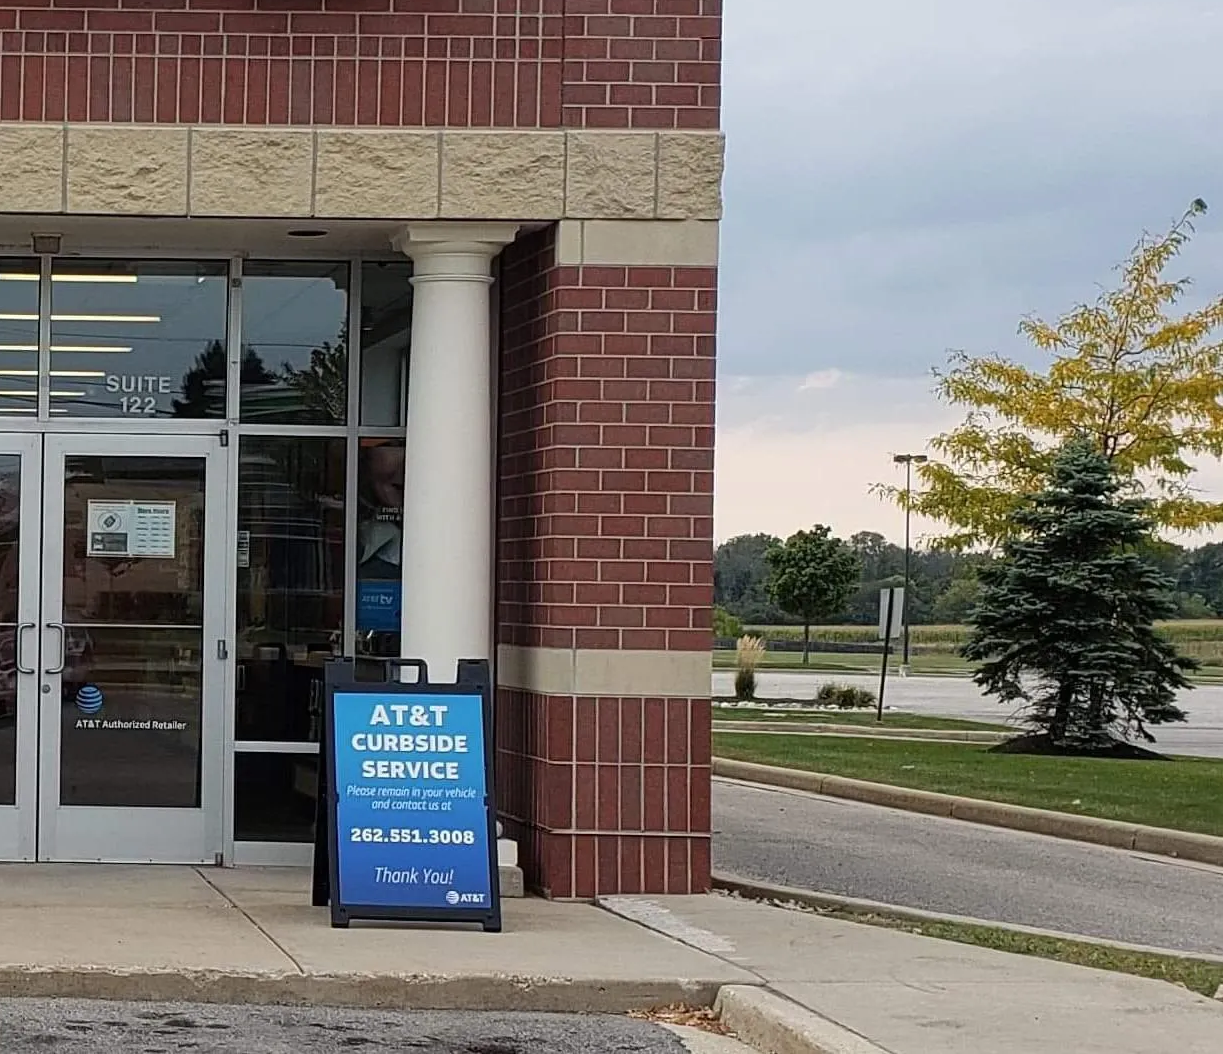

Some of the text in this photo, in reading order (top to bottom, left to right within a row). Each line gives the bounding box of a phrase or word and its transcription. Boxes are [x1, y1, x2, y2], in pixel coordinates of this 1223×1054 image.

[106, 375, 171, 393] SUITE
[120, 396, 156, 413] 122
[369, 704, 448, 726] AT&T
[76, 719, 187, 730] AT&T Authorized Retailer
[351, 733, 468, 752] CURBSIDE
[362, 760, 459, 779] SERVICE
[347, 785, 476, 800] Please remain in your vehicle
[372, 798, 452, 811] and contact us at
[350, 828, 475, 844] 262.551.3008
[375, 866, 454, 885] Thank You!
[460, 893, 486, 903] AT&T
